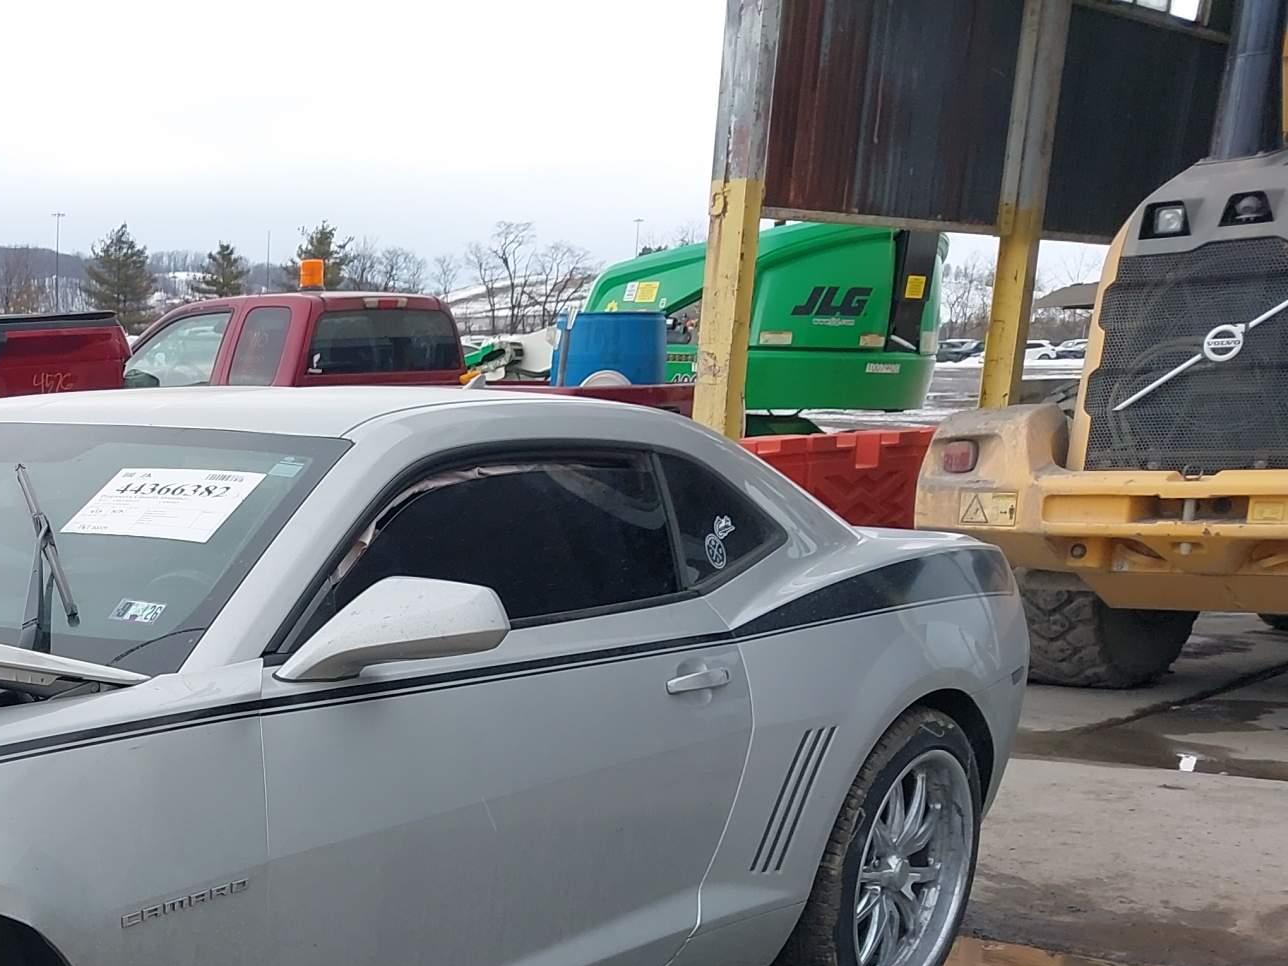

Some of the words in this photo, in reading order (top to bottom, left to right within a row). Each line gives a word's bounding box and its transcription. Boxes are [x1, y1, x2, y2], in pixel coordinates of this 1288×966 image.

[791, 286, 873, 316] JLG
[116, 482, 231, 498] 44366382
[121, 878, 249, 928] CAMARO
